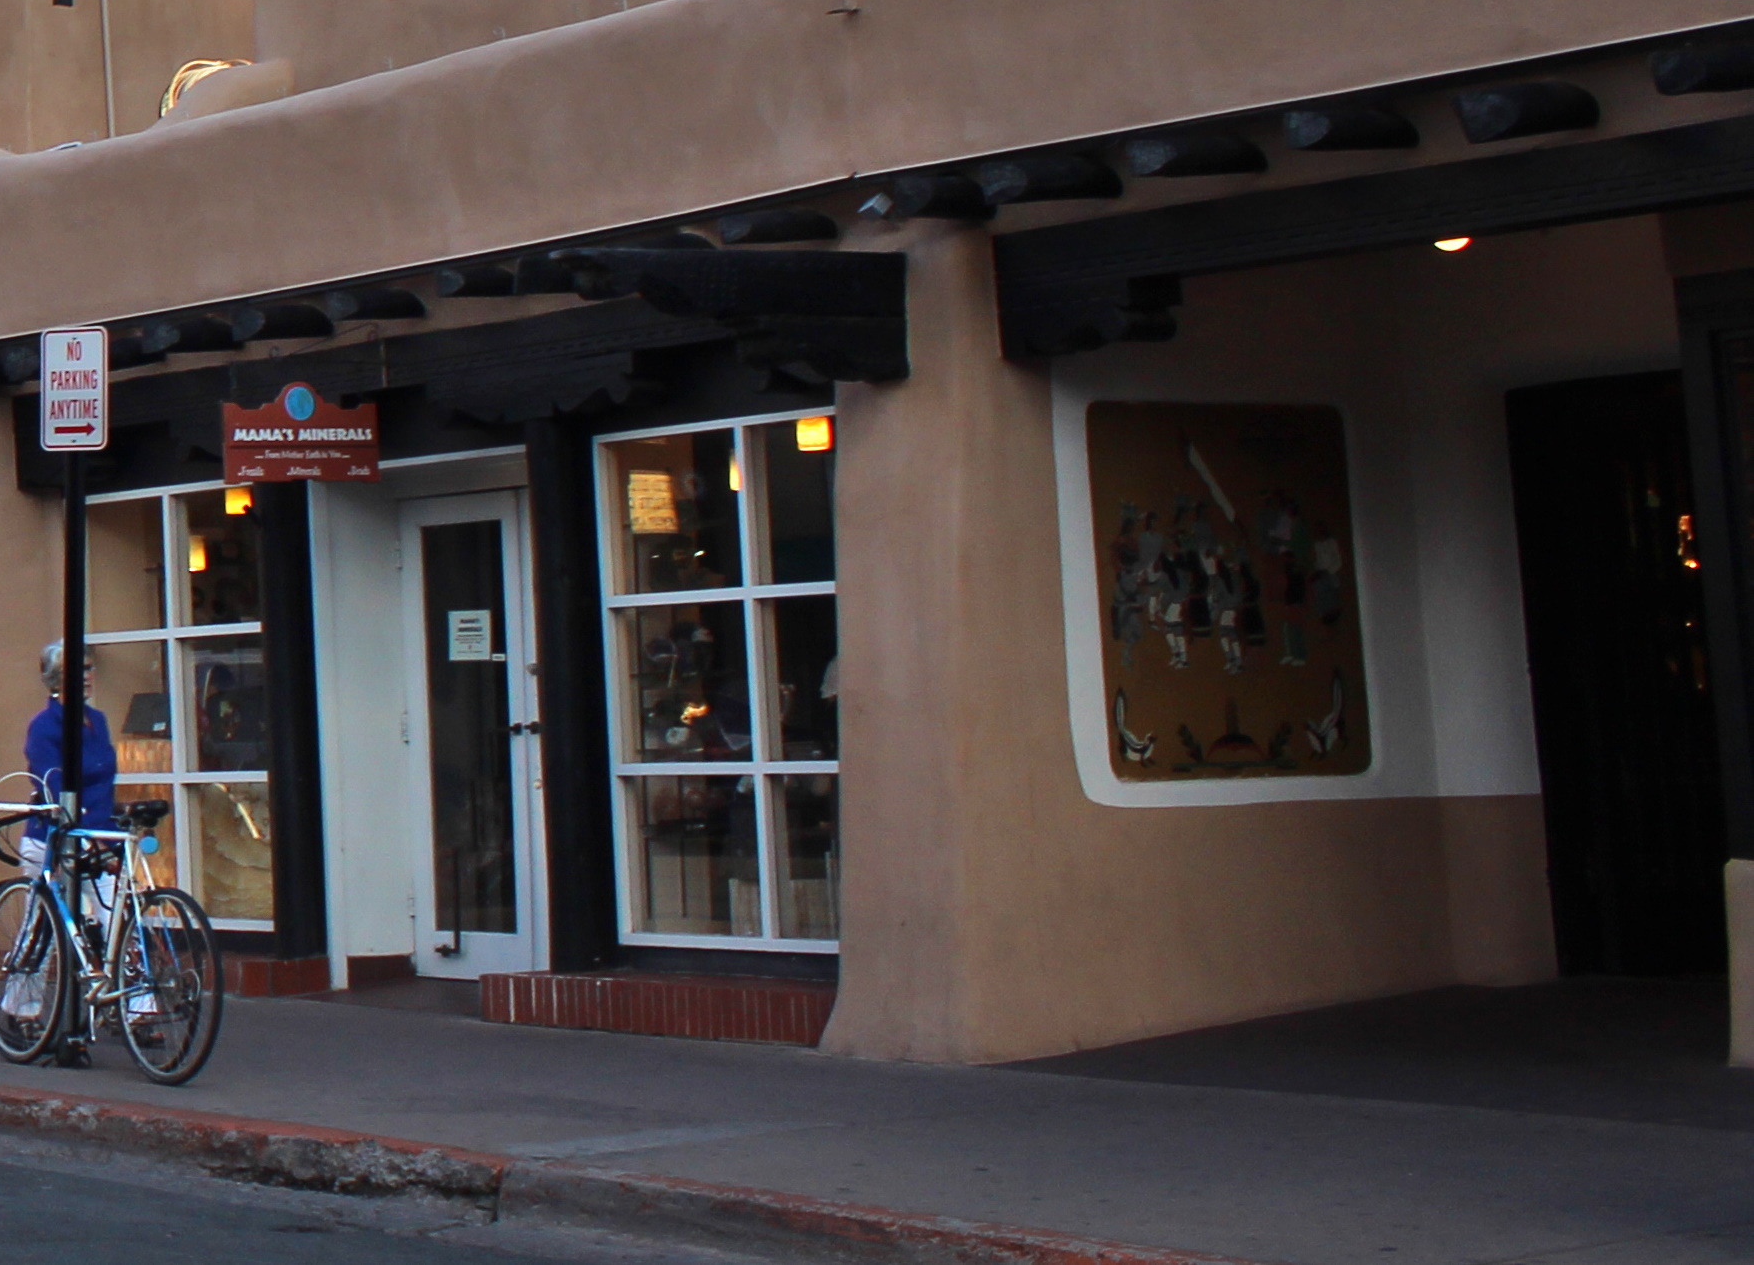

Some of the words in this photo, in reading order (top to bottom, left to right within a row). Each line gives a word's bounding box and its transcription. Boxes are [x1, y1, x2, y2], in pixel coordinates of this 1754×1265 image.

[67, 341, 82, 361] NO
[51, 369, 98, 391] PARKING
[50, 398, 99, 420] ANYTIME
[233, 428, 295, 441] MAMA'S
[298, 428, 372, 441] MINERALS
